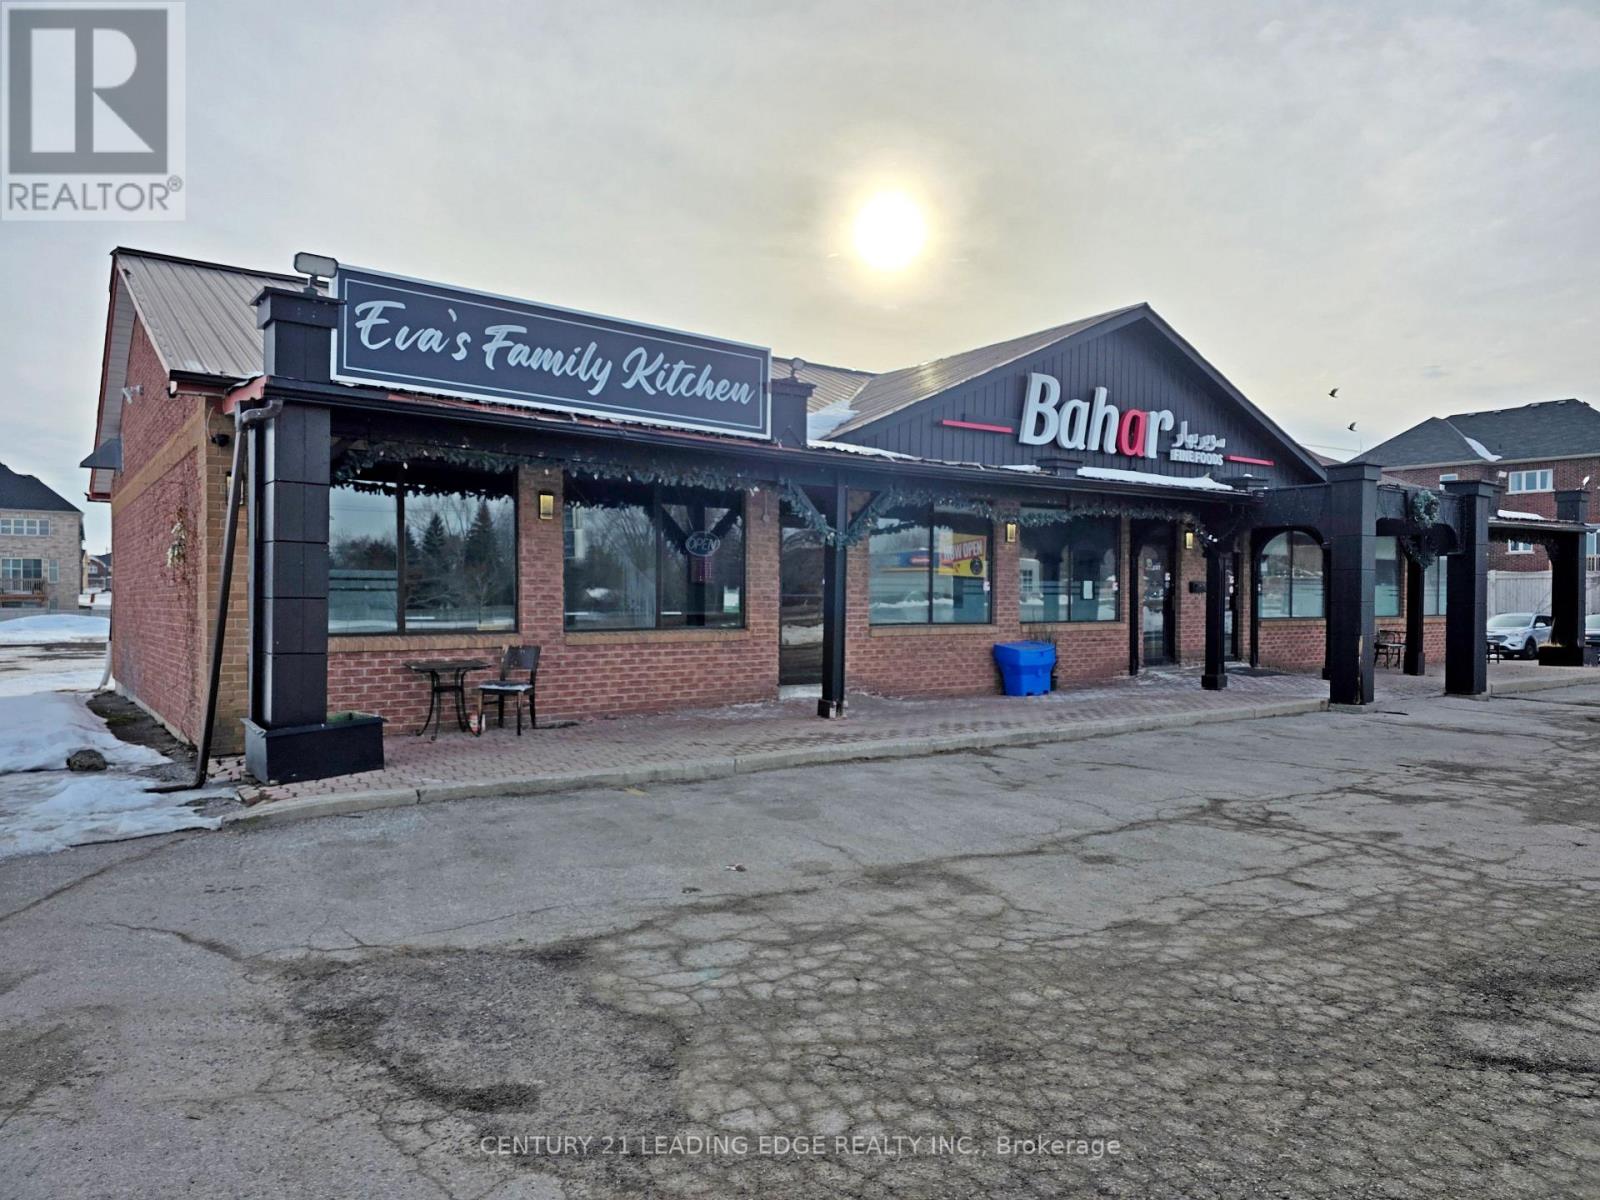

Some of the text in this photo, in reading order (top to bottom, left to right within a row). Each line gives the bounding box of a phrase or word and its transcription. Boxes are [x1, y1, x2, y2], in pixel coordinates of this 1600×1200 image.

[354, 300, 756, 405] Eva's Family Kitchen
[1018, 372, 1175, 459] Bahar
[688, 537, 718, 551] OPEN
